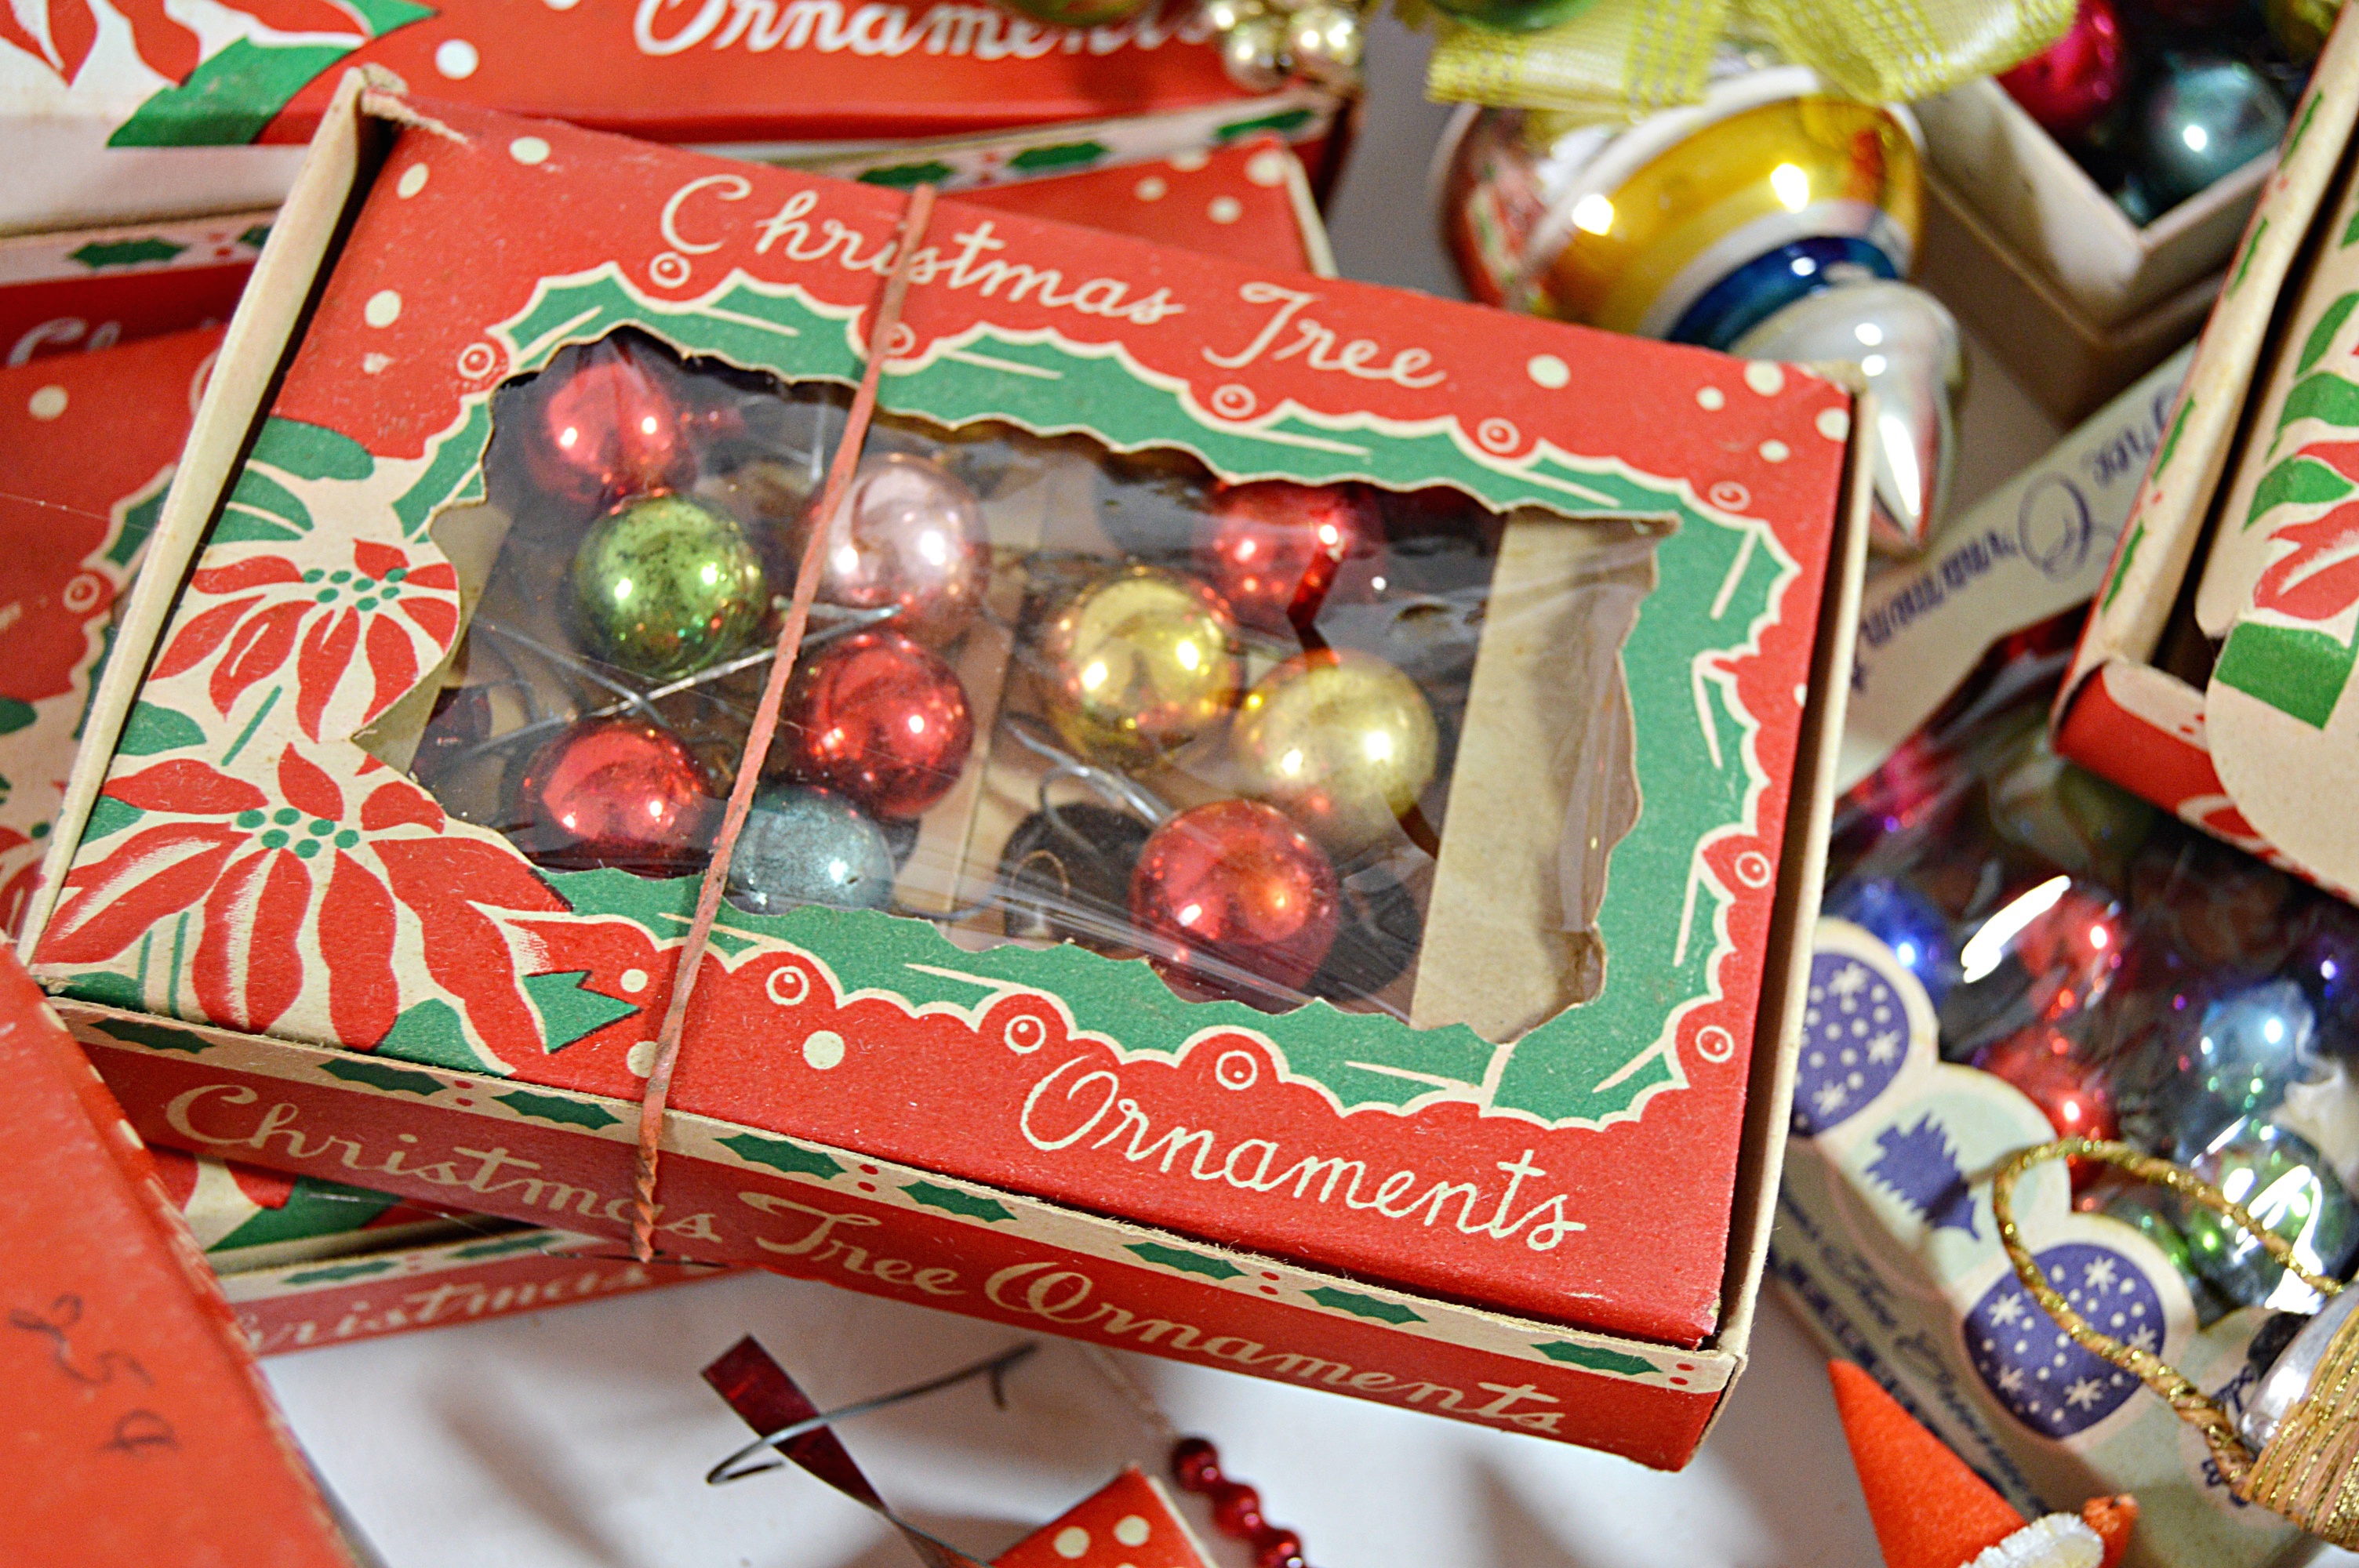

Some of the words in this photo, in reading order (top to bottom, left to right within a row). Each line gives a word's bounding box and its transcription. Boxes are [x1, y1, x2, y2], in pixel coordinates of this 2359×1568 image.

[661, 174, 1186, 325] Christmas
[1203, 281, 1445, 388] Tree
[1852, 470, 2119, 696] Ornamen
[165, 1083, 723, 1243] Christmas
[738, 1191, 967, 1295] Tree
[983, 1261, 1563, 1434] Ornaments
[1020, 1054, 1587, 1251] Ornaments
[237, 1265, 650, 1352] hristmas
